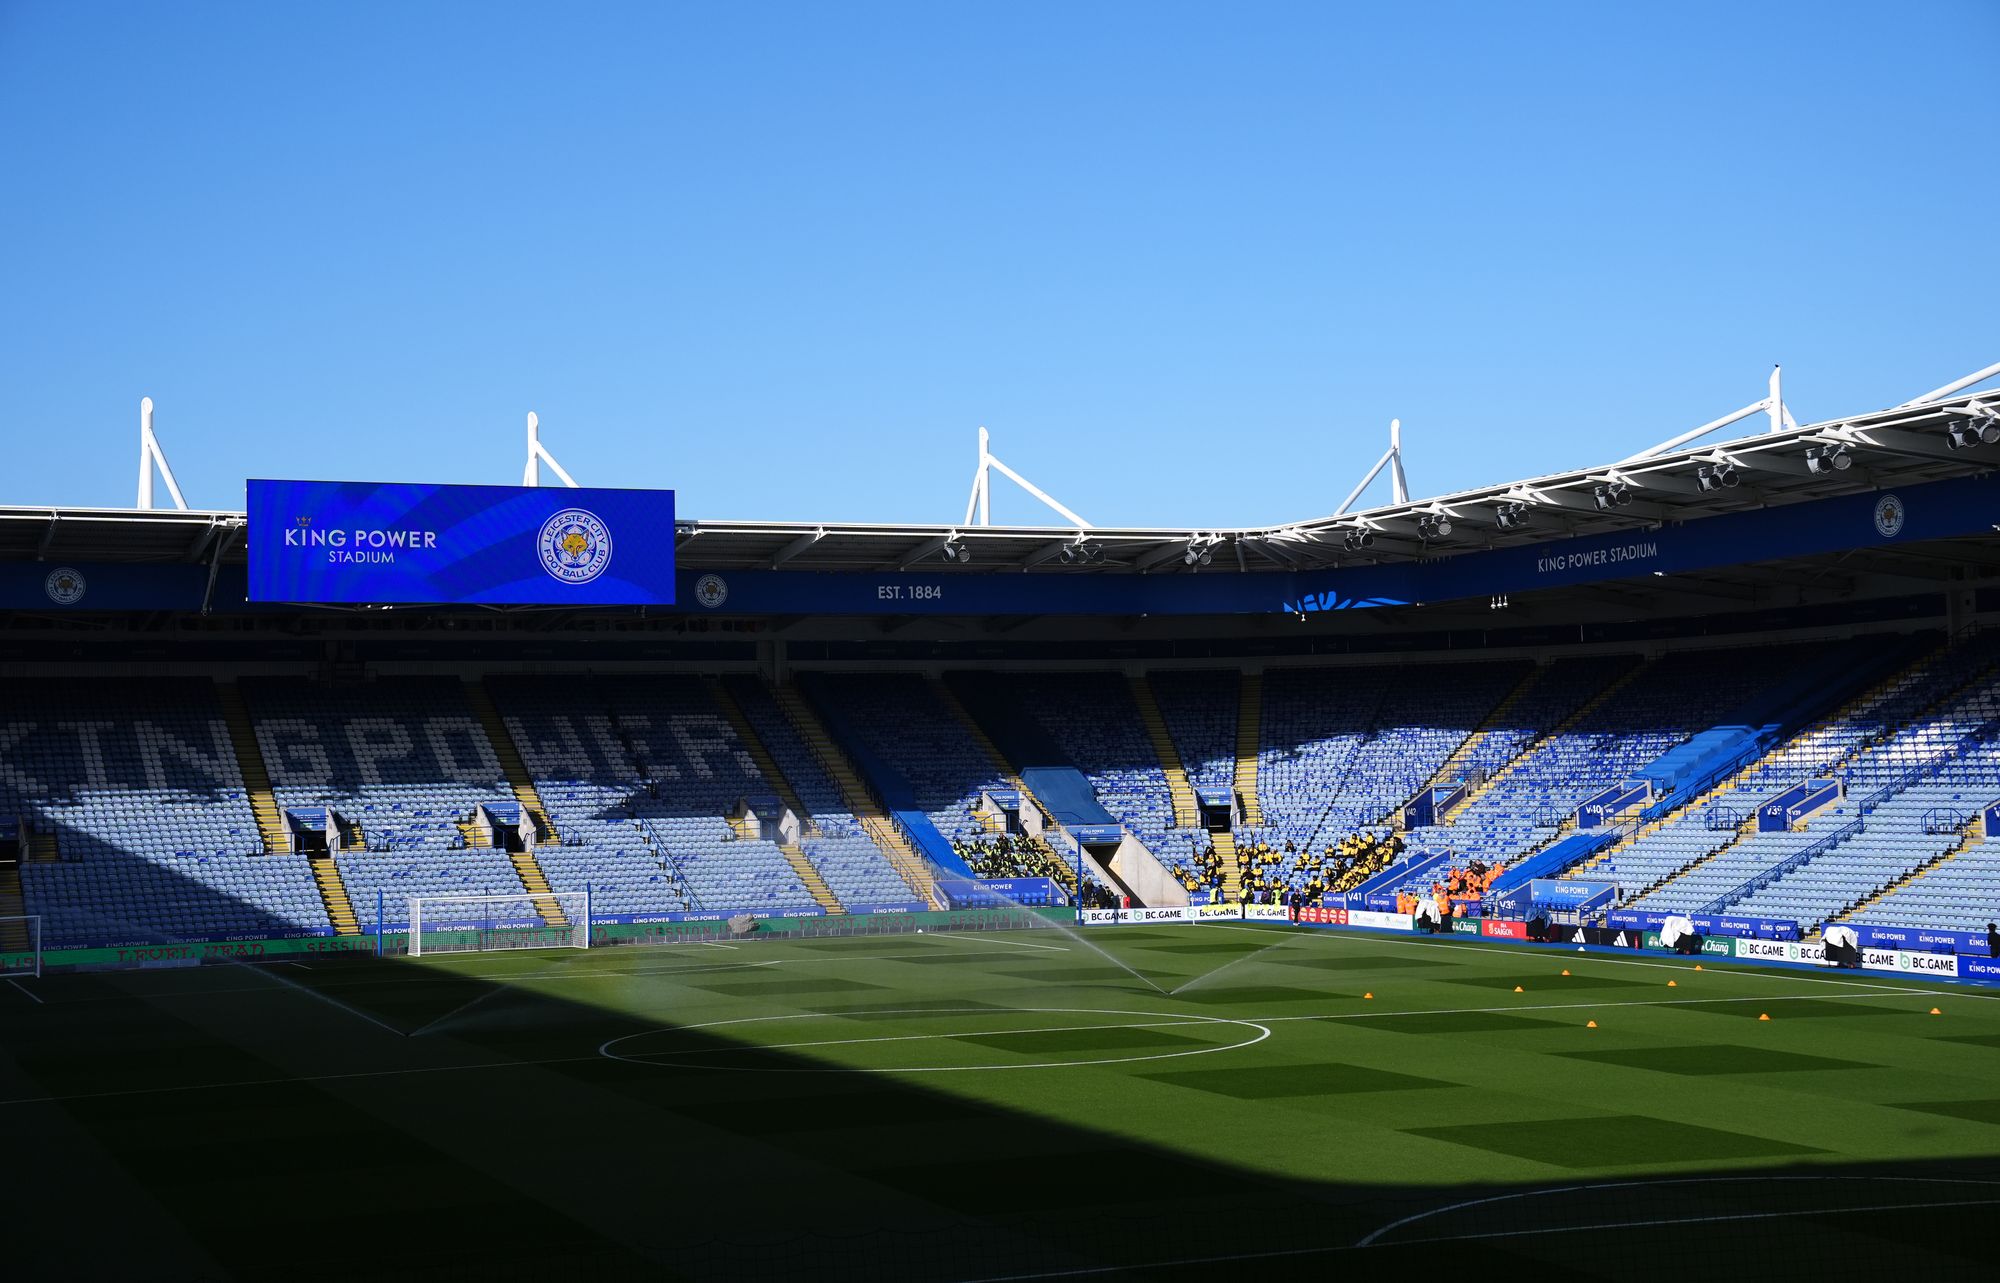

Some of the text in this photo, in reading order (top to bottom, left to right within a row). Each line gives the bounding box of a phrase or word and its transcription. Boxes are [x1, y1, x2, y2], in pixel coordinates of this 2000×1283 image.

[544, 514, 606, 544] LEICESTER CITY
[285, 528, 436, 548] KING POWER
[328, 550, 394, 564] STADIUM
[544, 548, 606, 578] FOOTBALL CLUB
[1538, 542, 1657, 572] KING POWER STADIUM
[878, 585, 942, 599] EST. 1884
[1766, 806, 1782, 816] V39
[1348, 892, 1362, 901] V41
[1570, 887, 1589, 895] POWER
[1146, 910, 1181, 919] BC.GAME
[1460, 921, 1477, 934] Chang
[1705, 940, 1729, 956] Chang
[1750, 944, 1784, 956] BC.GAME
[1801, 948, 1826, 960] BC.GA
[1856, 952, 1894, 966] BC.GAME
[1913, 957, 1954, 971] BC.GAME
[1969, 965, 2000, 974] KING POW
